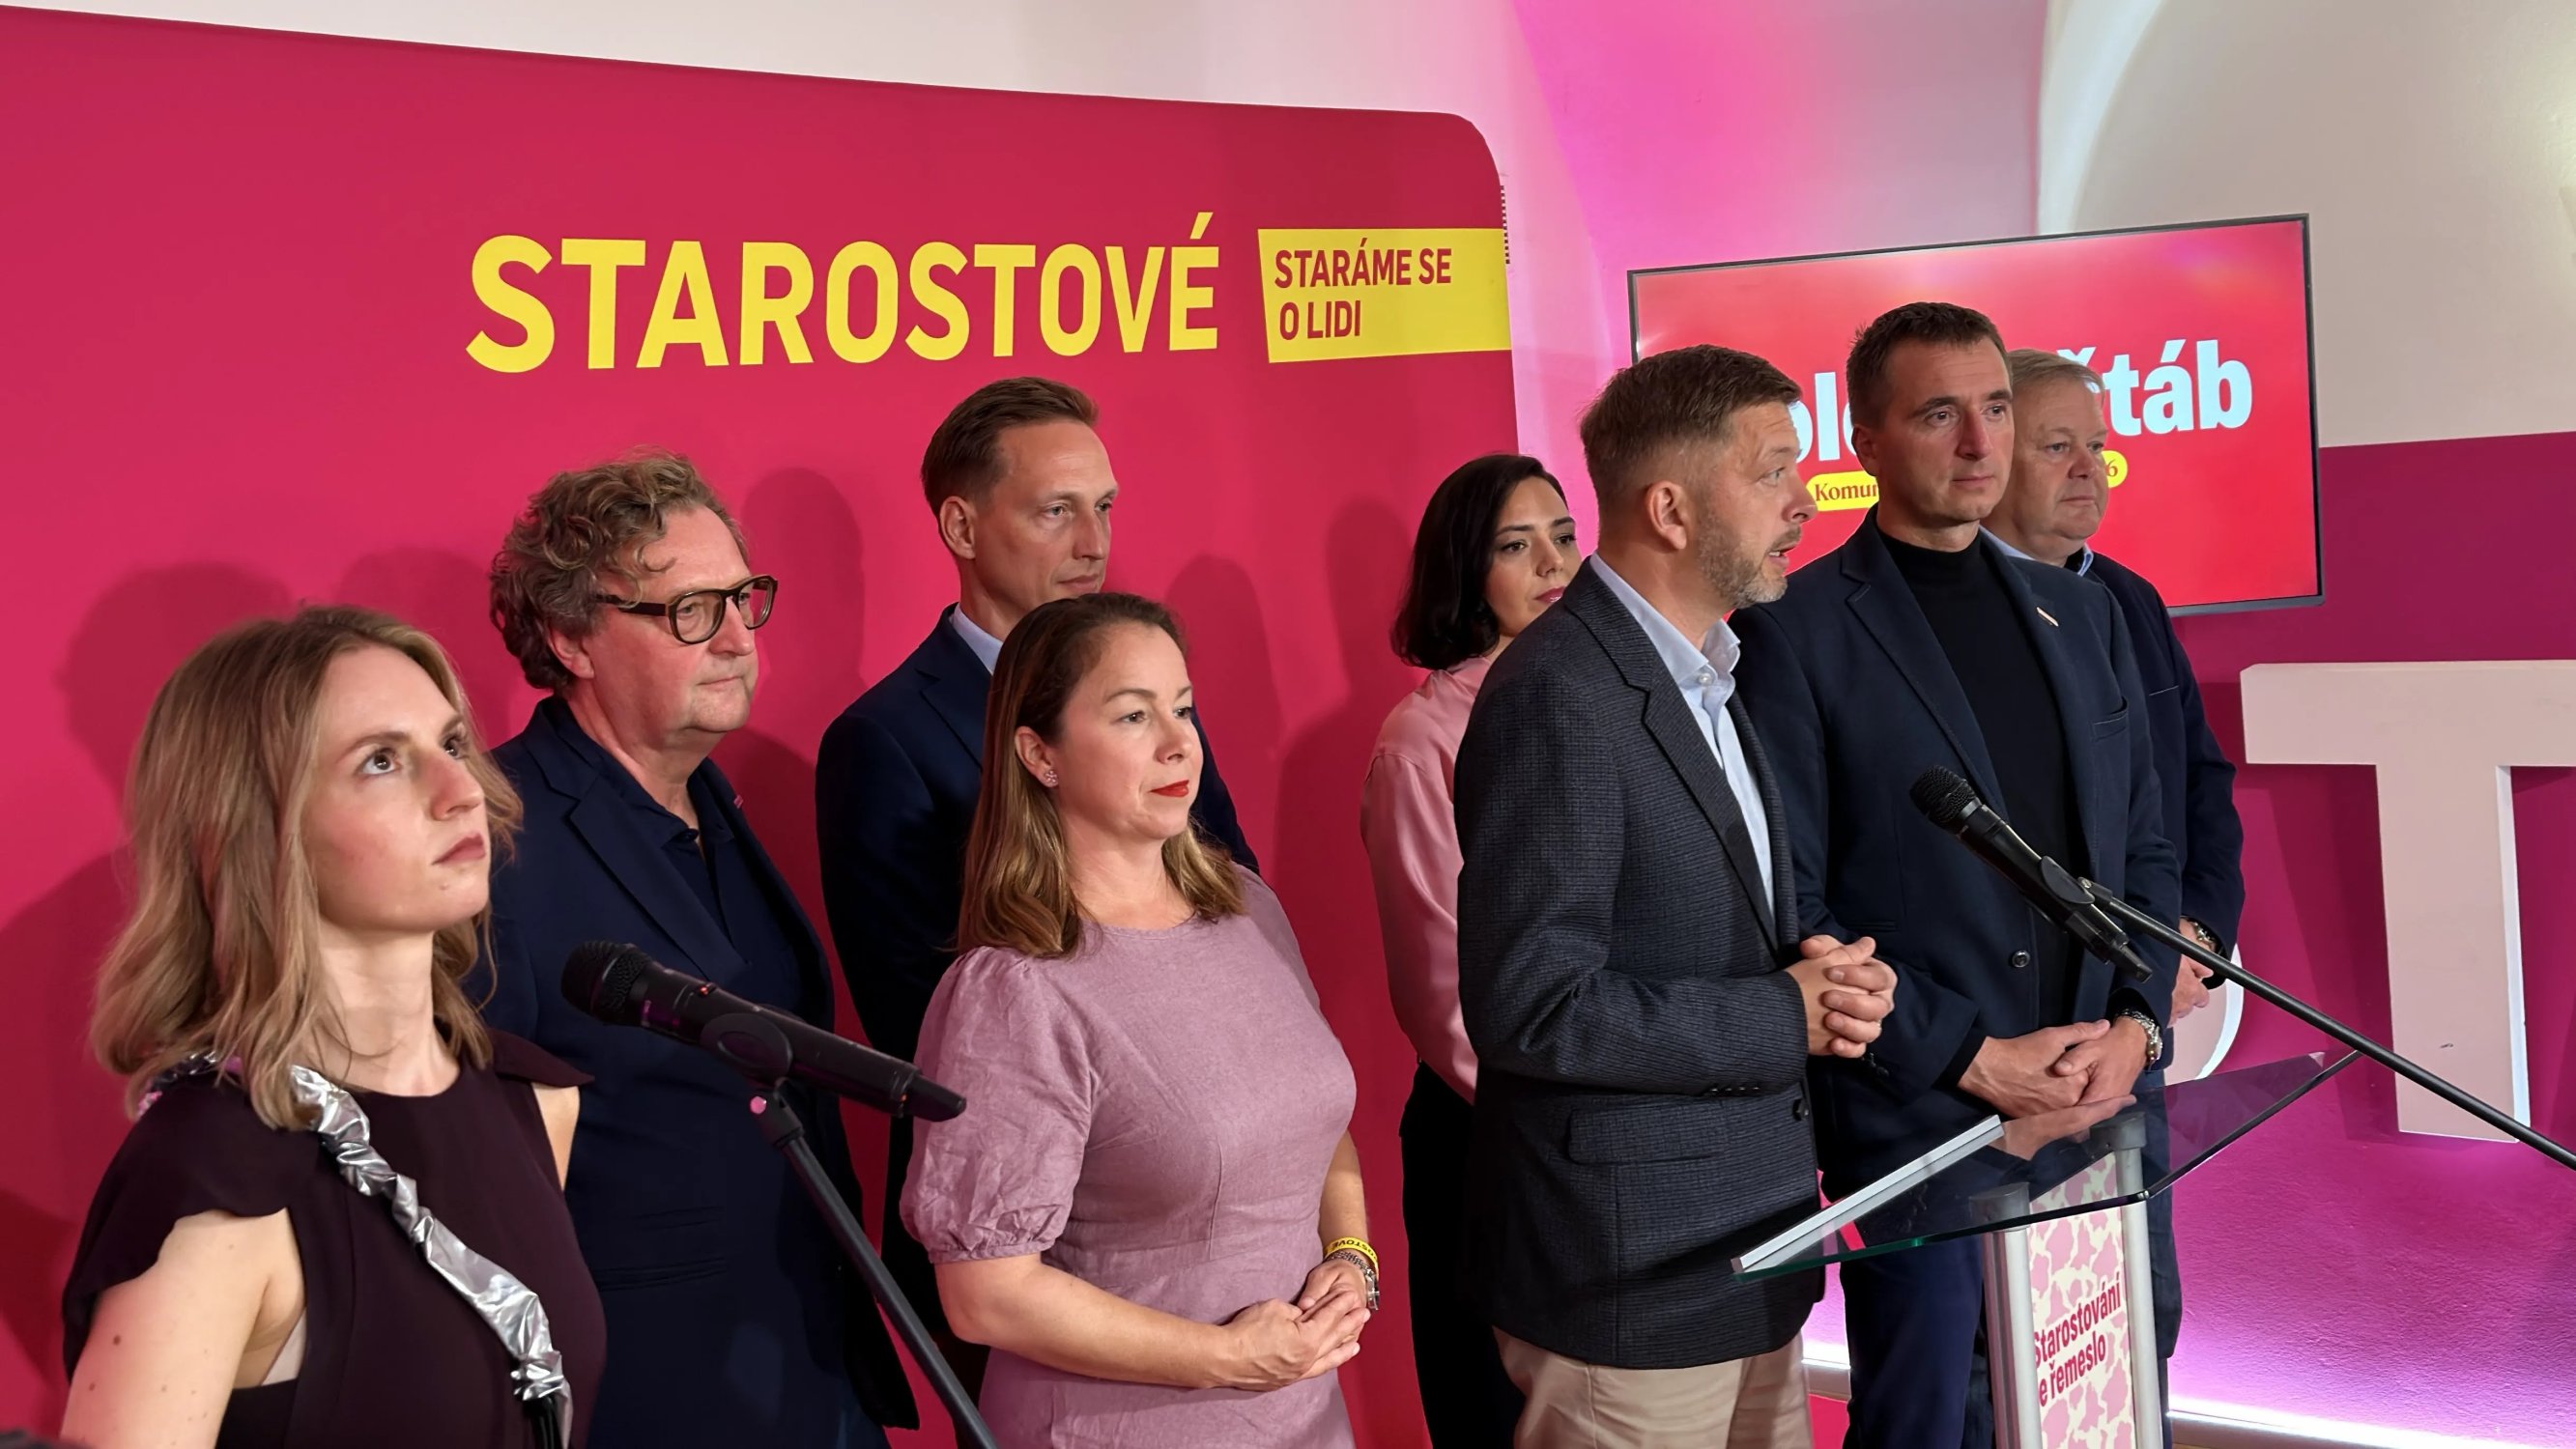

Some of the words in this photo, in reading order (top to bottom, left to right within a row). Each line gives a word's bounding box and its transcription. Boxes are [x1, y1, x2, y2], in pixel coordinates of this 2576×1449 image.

[466, 212, 1219, 373] STAROSTOVÉ
[1274, 238, 1412, 289] STARÁME
[1418, 247, 1452, 285] SE
[1279, 301, 1300, 341] O
[1306, 300, 1361, 339] LIDI
[2057, 339, 2252, 437] táb
[2034, 1271, 2122, 1370] Starostování
[2049, 1331, 2106, 1400] řemeslo
